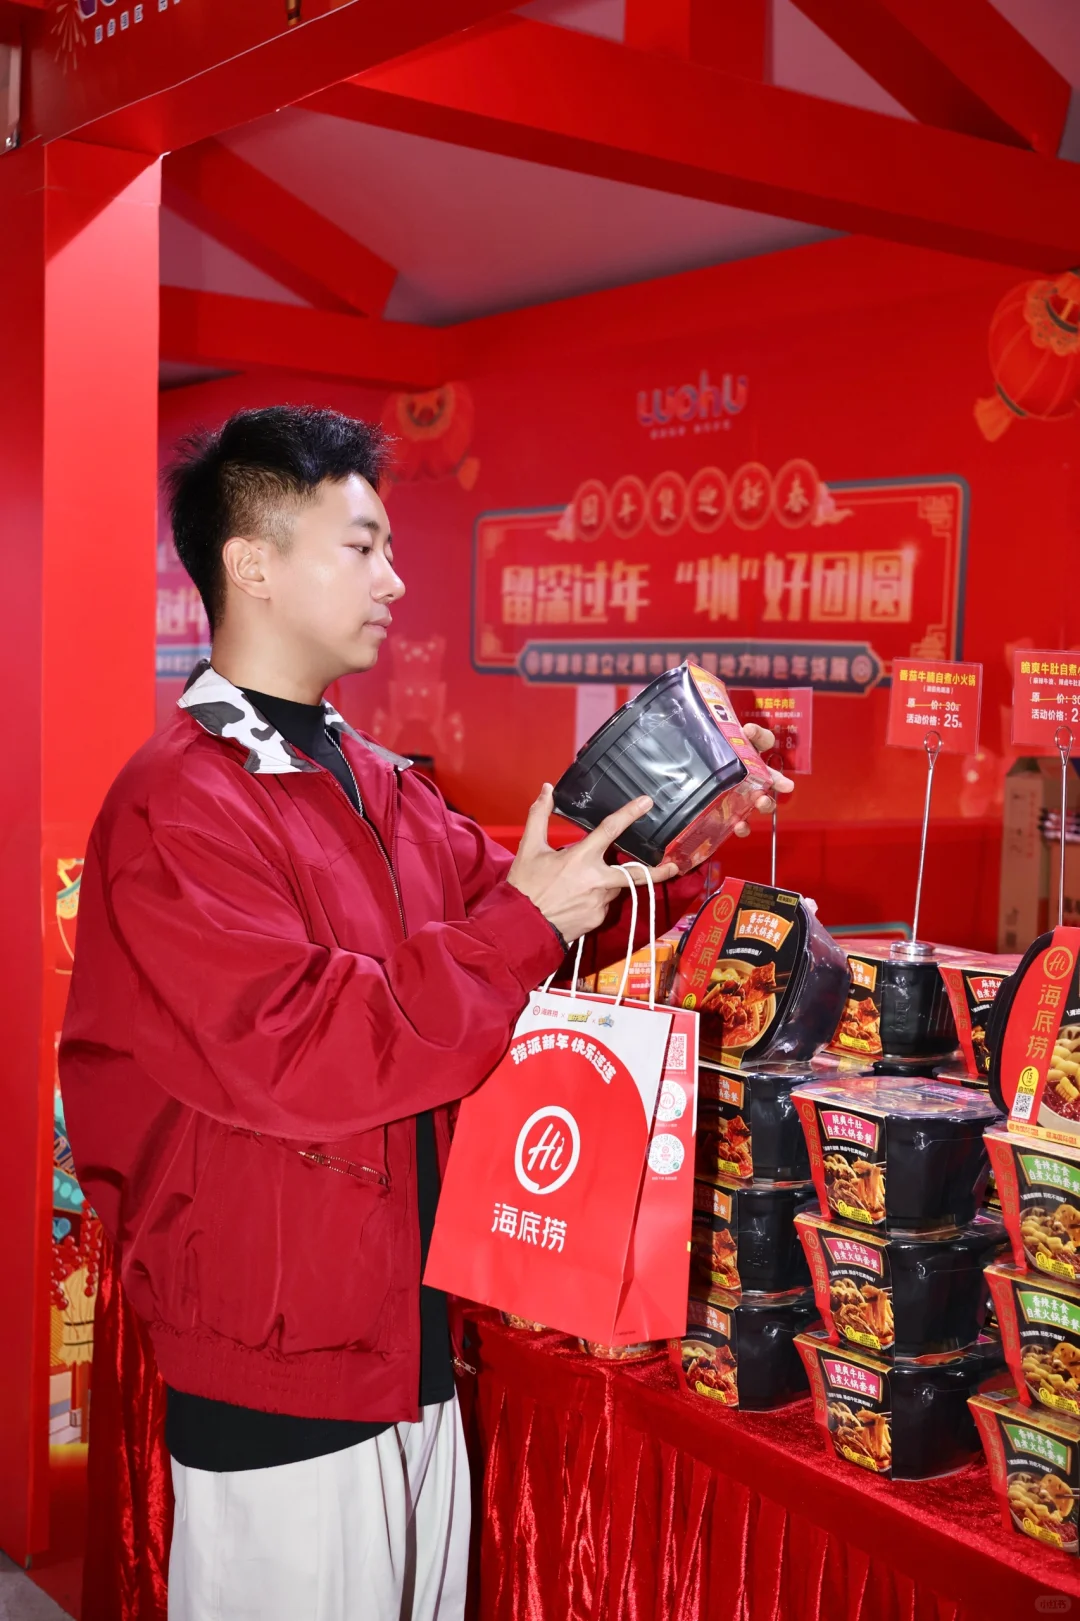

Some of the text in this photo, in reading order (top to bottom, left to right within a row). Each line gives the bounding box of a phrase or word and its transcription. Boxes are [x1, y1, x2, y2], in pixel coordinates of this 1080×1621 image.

[502, 560, 650, 625] 留深过年
[900, 669, 976, 687] 番茄牛腩自煮小火锅
[749, 912, 779, 930] 番茄牛腩
[738, 924, 781, 943] 自煮火锅套餐
[689, 925, 724, 988] 海底捞
[1025, 983, 1063, 1060] 海底捞
[510, 1033, 617, 1084] 捞派新年 快乐连连
[832, 1114, 863, 1130] 脆爽牛肚
[827, 1125, 873, 1145] 自煮火锅套餐
[527, 1123, 566, 1171] Hi
[1034, 1158, 1070, 1177] 香辣素食
[1029, 1169, 1080, 1193] 自煮火锅套餐
[490, 1202, 568, 1253] 海底捞
[836, 1240, 869, 1256] 脆爽牛肚
[833, 1251, 879, 1270] 自煮火锅套餐
[1032, 1295, 1069, 1315] 香辣素食
[1026, 1306, 1080, 1331] 自煮火锅套餐
[834, 1363, 867, 1381] 脆爽牛肚
[830, 1373, 877, 1396] 自煮火锅套餐
[1018, 1428, 1054, 1451] 香辣素食
[1014, 1437, 1066, 1466] 自煮火锅套餐
